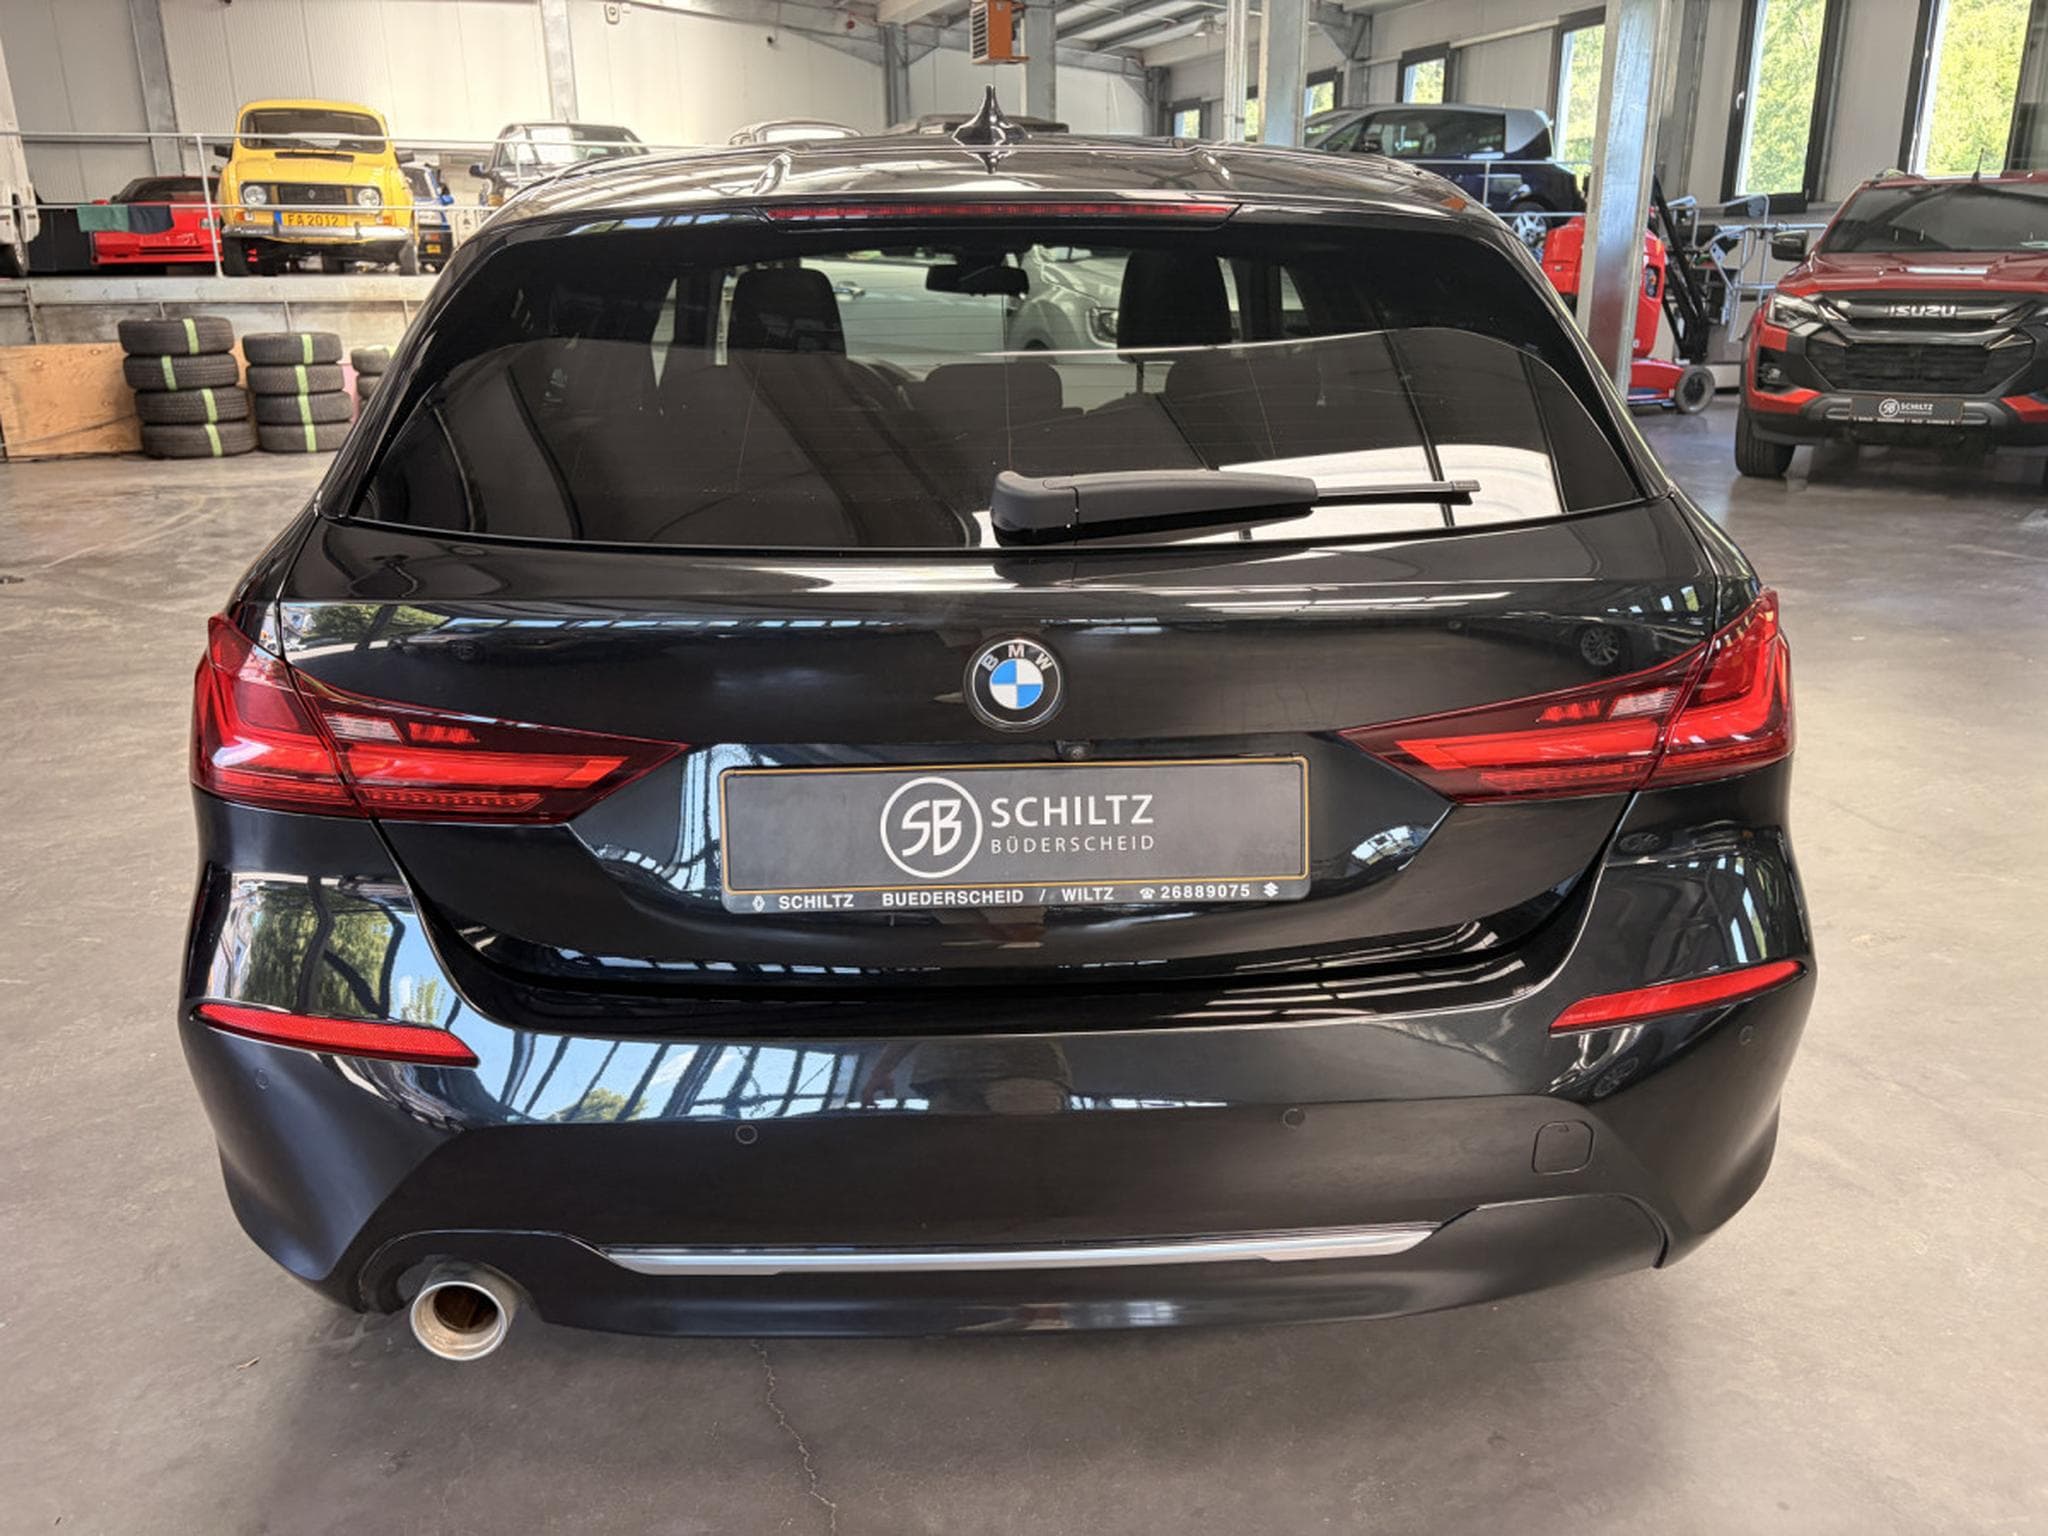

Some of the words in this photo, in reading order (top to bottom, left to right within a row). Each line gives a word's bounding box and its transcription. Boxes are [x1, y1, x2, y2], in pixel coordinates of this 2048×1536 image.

[1889, 305, 1956, 318] ISUZU
[980, 644, 1054, 672] BMW
[990, 794, 1155, 828] SCHILTZ
[990, 834, 1155, 855] BÜDERSCHEID
[778, 893, 855, 910] SCHILTZ
[881, 889, 1025, 907] BUEDERSCHEID
[1060, 886, 1115, 902] WILTZ
[1159, 883, 1251, 899] 26889075
